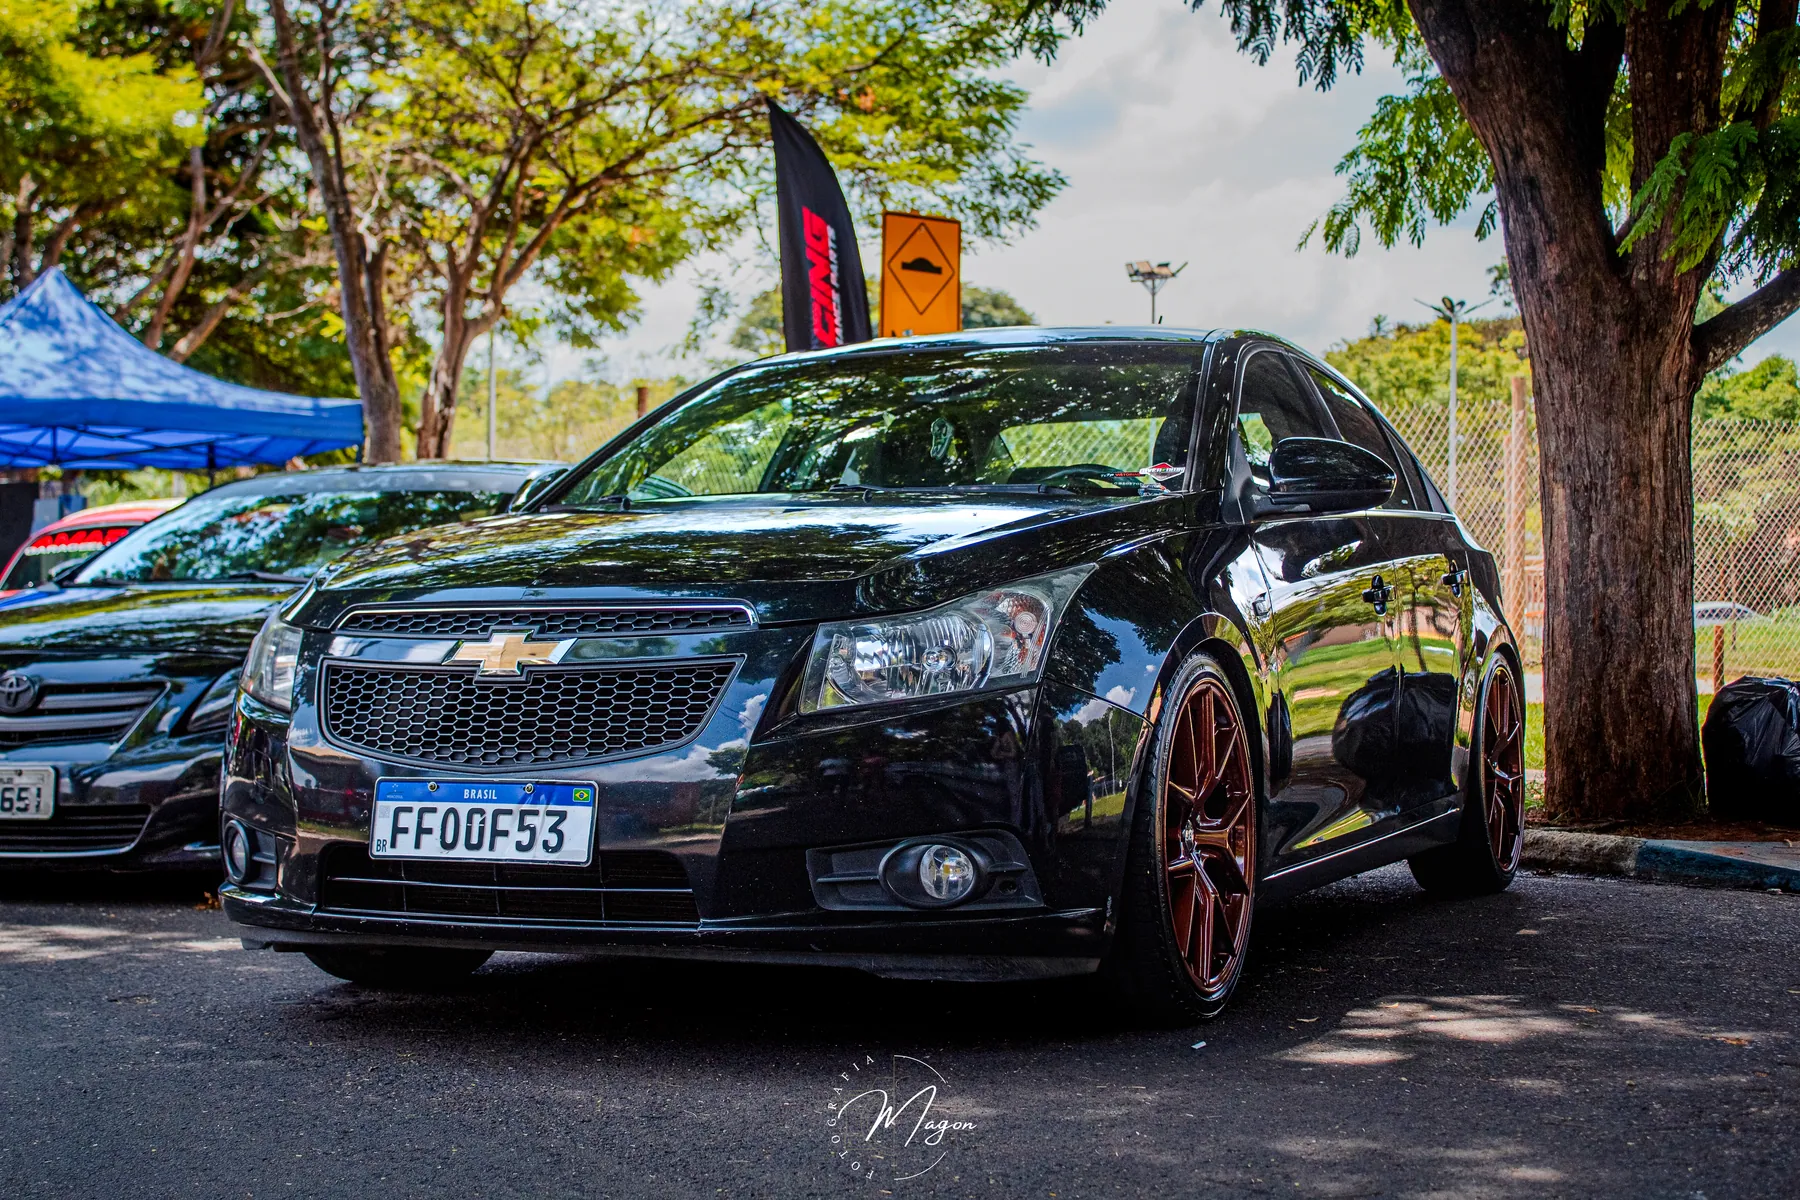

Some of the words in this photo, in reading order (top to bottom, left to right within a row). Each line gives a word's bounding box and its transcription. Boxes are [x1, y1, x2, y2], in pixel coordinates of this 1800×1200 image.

[826, 224, 840, 289] PARTS
[463, 788, 497, 800] BRASIL
[376, 838, 387, 853] BR
